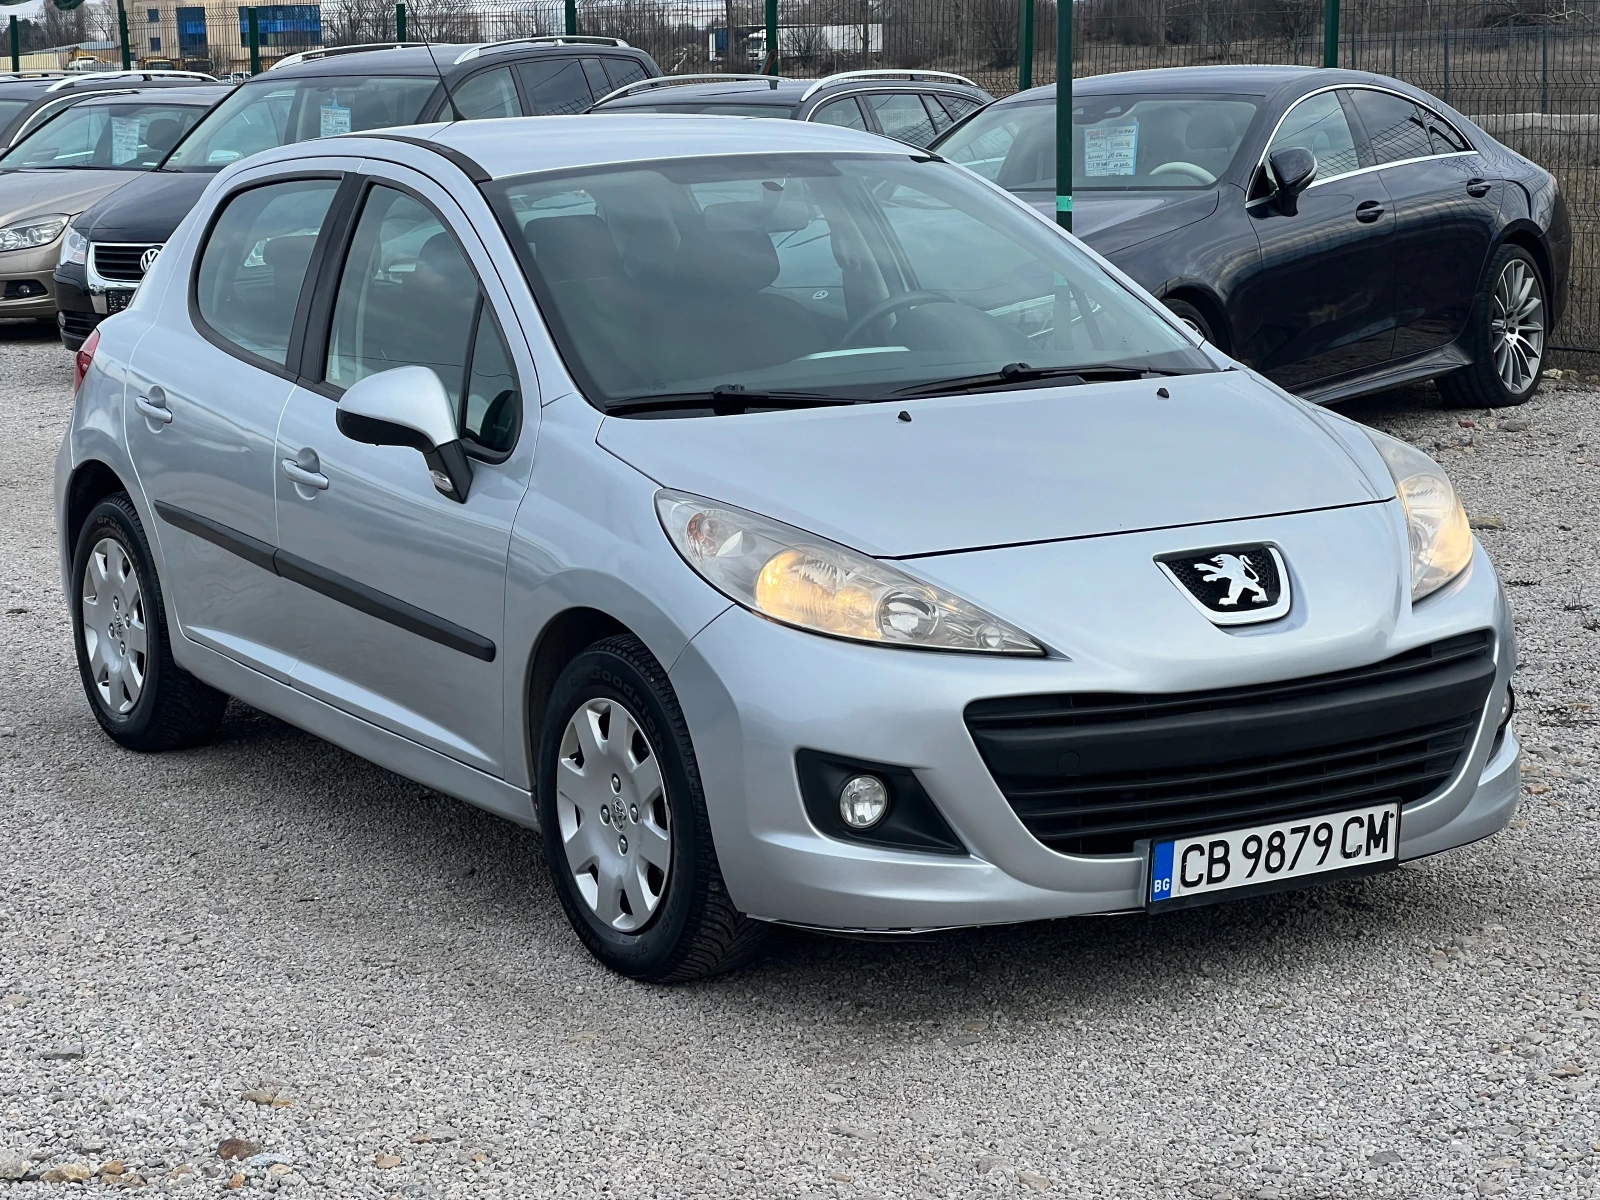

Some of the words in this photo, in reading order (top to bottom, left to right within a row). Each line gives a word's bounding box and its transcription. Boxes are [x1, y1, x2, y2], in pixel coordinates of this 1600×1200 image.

[1180, 839, 1231, 888] CB
[1241, 822, 1334, 879] 9879
[1340, 810, 1390, 859] CM
[1154, 878, 1170, 893] BG
